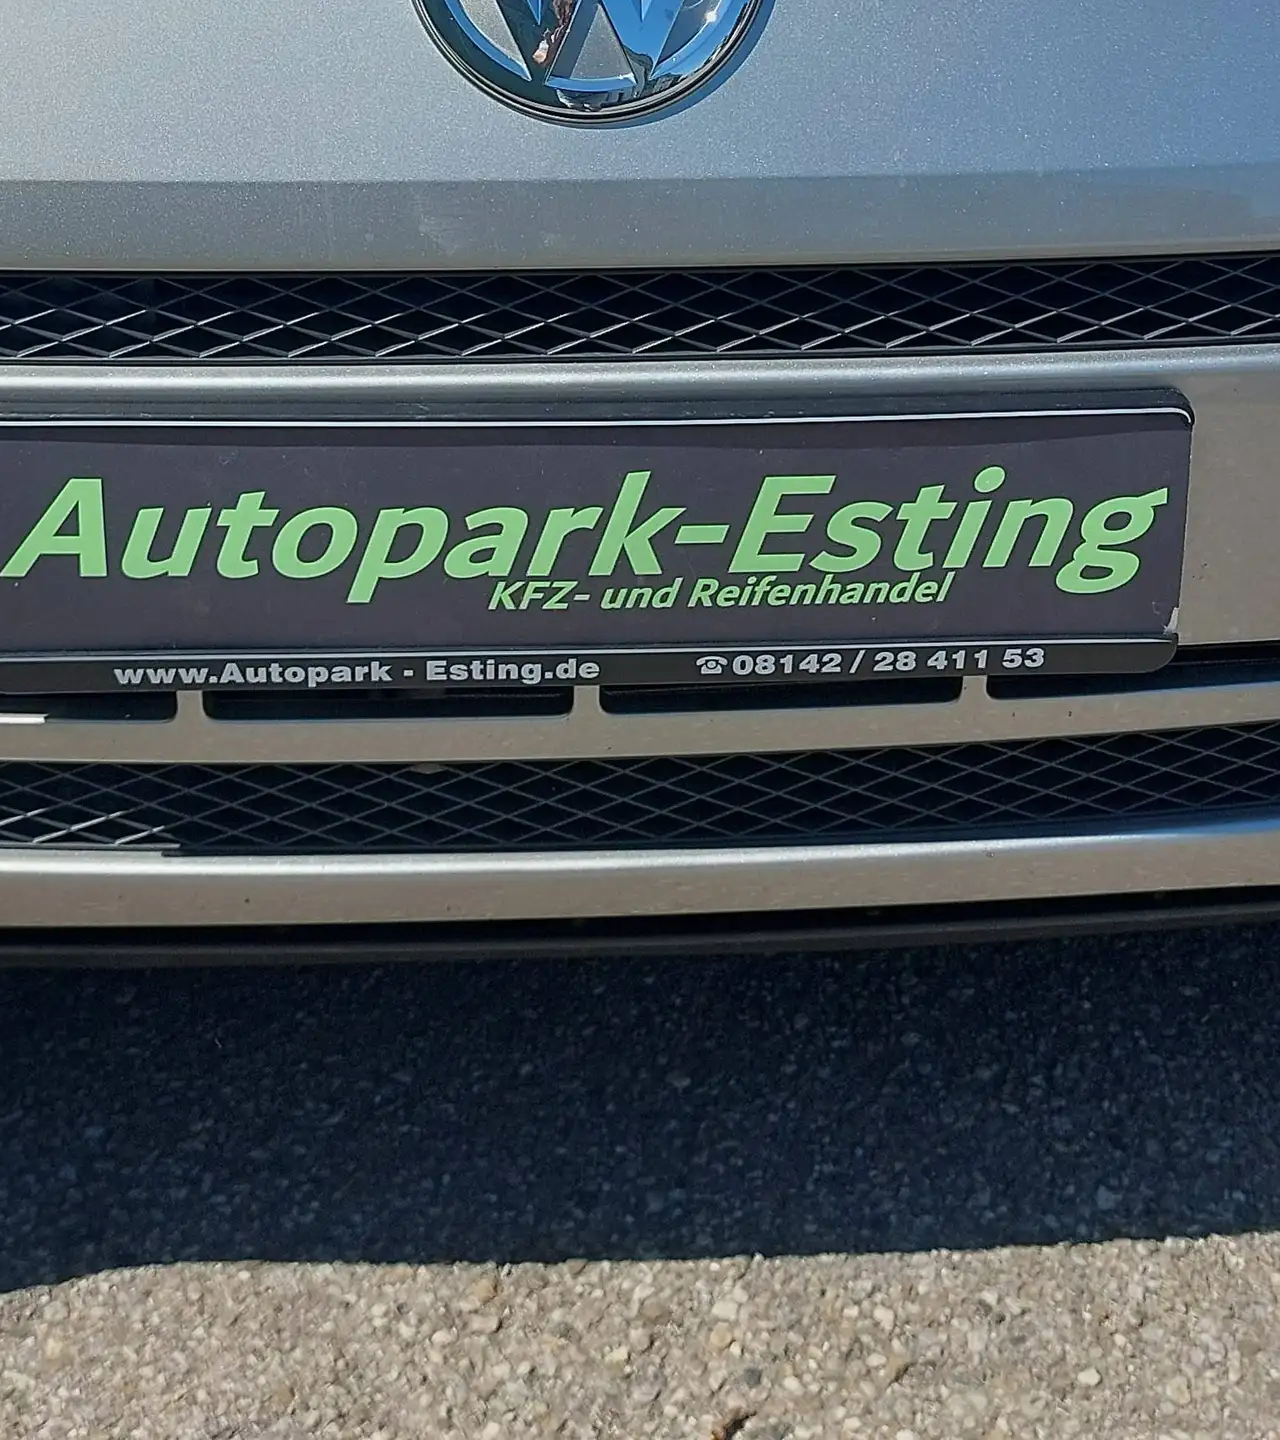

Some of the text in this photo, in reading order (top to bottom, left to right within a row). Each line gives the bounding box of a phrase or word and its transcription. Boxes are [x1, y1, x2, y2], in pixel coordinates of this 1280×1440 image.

[487, 570, 957, 611] KFZ- und Reifenhandel
[113, 659, 394, 688] www.Autopark
[424, 658, 601, 685] Esting.de
[731, 652, 843, 676] 08142
[872, 650, 918, 673] 28
[926, 649, 990, 671] 411
[1002, 647, 1045, 669] 53
